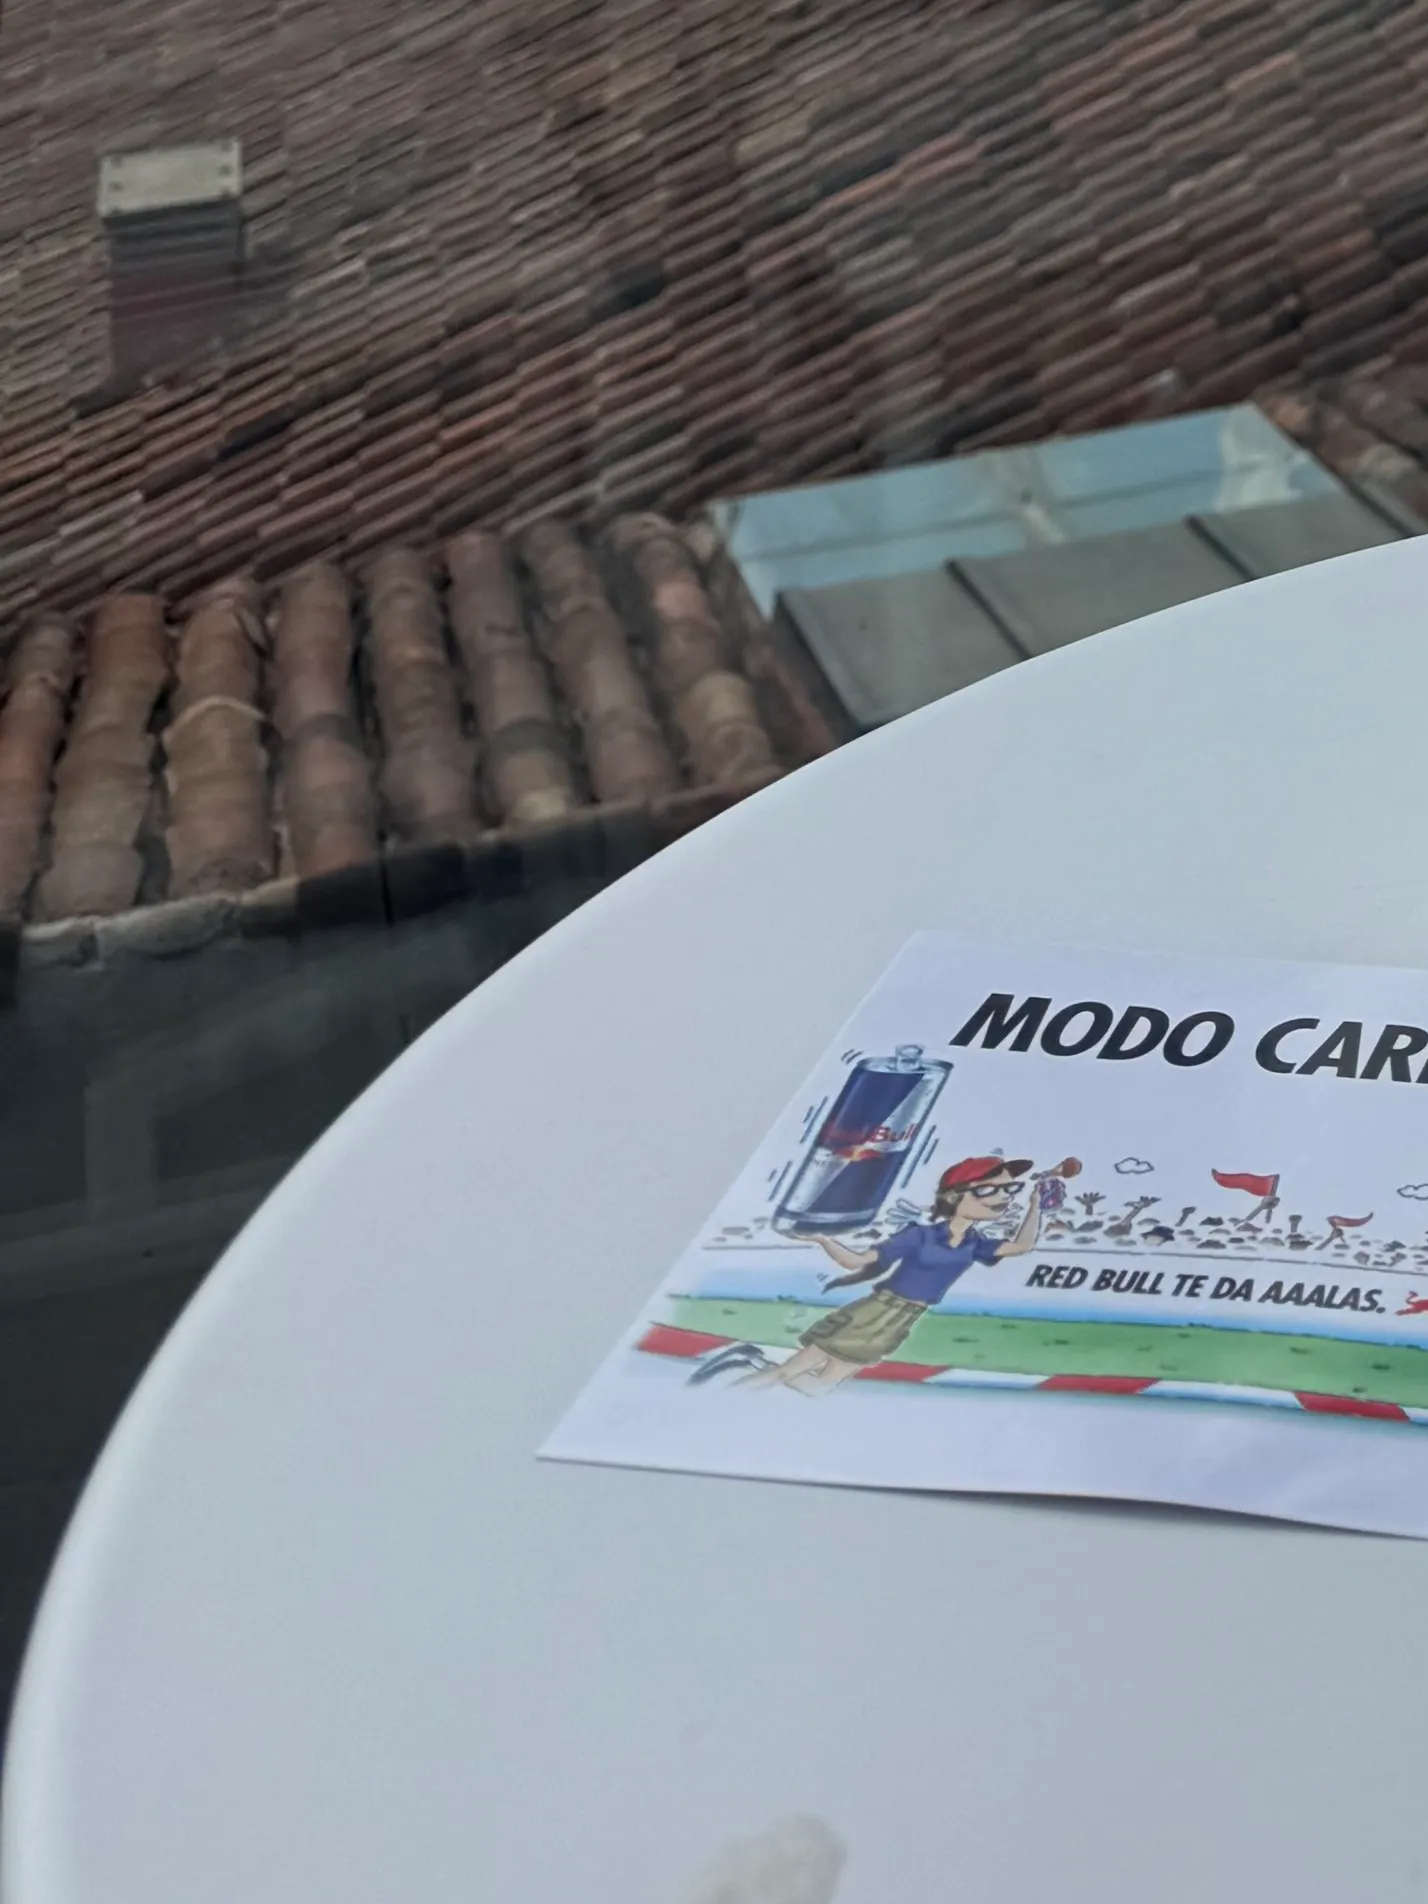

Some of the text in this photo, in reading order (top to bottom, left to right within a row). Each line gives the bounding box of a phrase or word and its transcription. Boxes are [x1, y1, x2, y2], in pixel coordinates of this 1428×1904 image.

[948, 992, 1236, 1068] MODO
[1024, 1263, 1387, 1314] RED BULL TE DA AAALAS.
